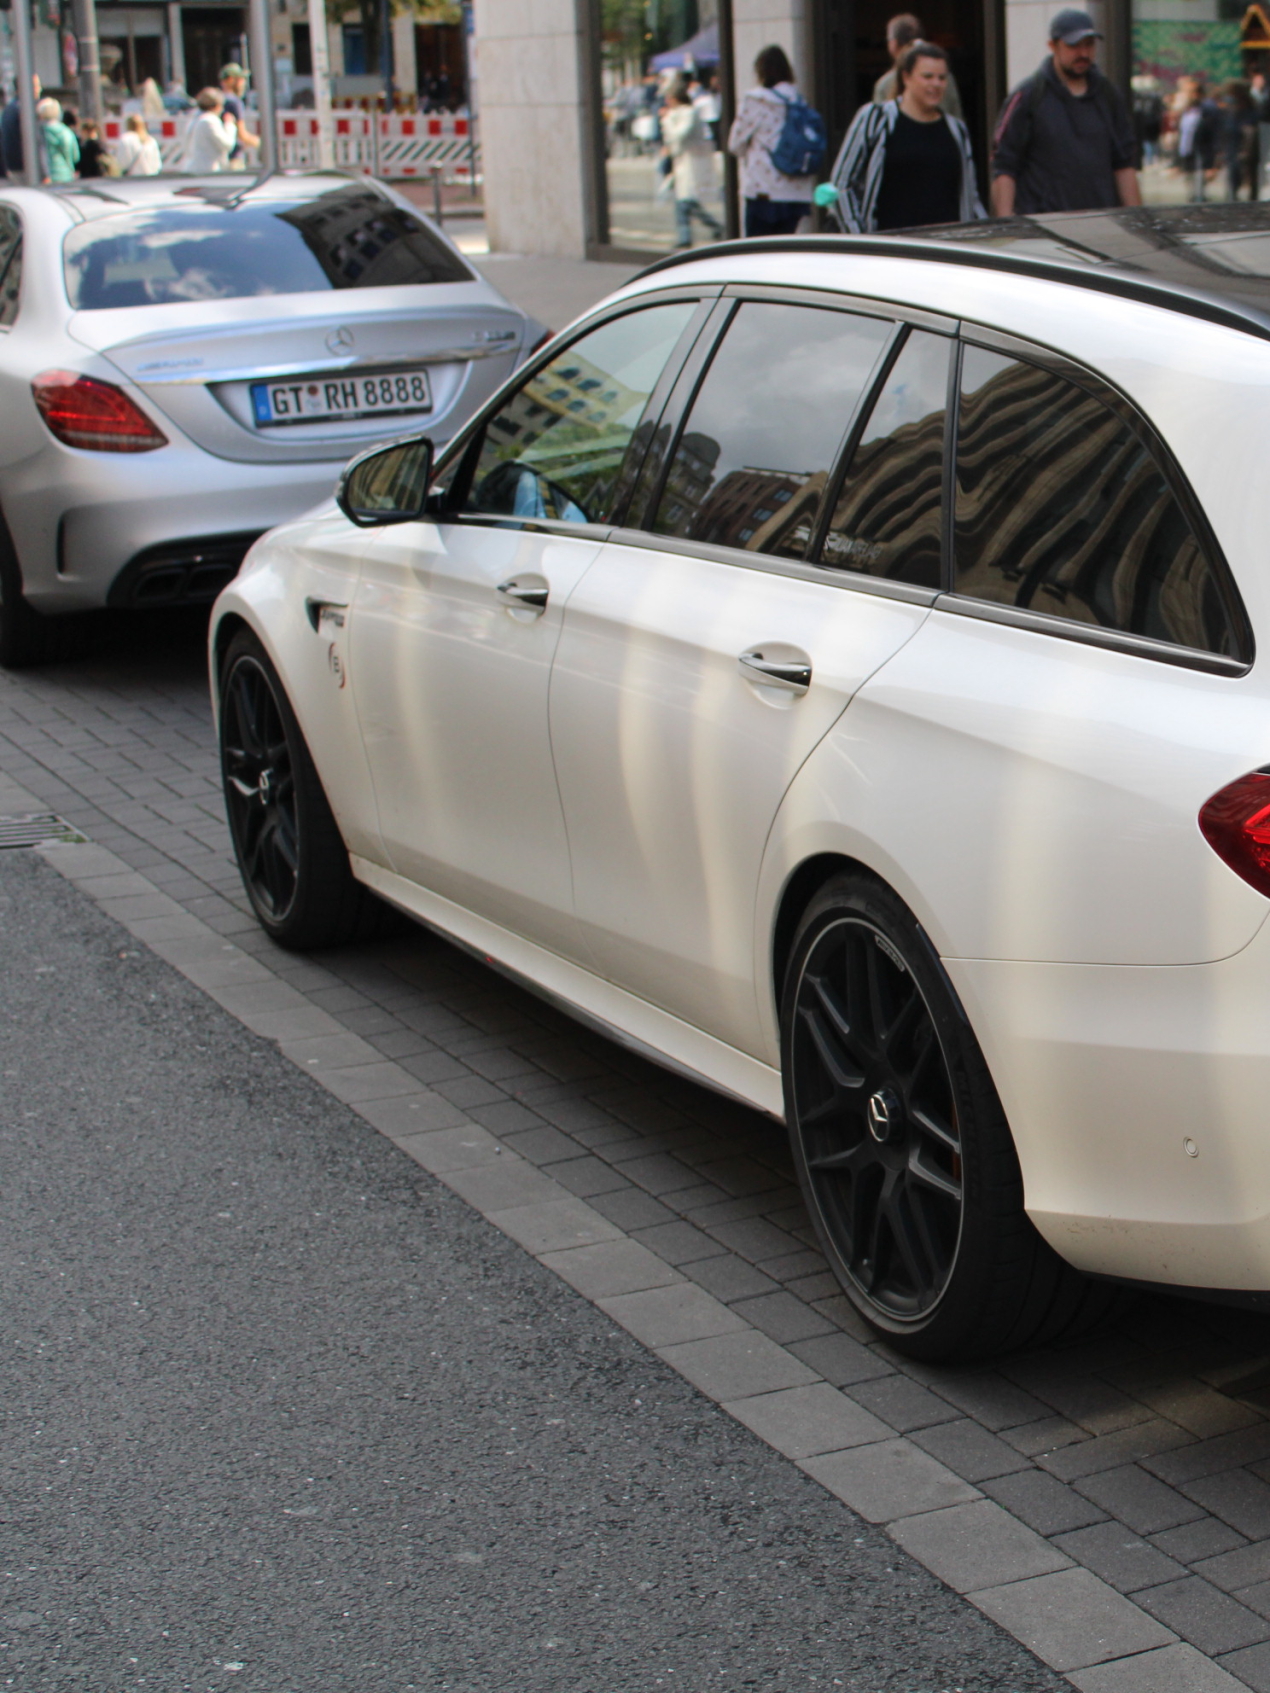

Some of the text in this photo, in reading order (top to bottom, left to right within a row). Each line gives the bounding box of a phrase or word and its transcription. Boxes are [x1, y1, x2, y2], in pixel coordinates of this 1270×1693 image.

[272, 387, 304, 415] GT
[324, 382, 358, 410] RH
[364, 377, 426, 406] 8888
